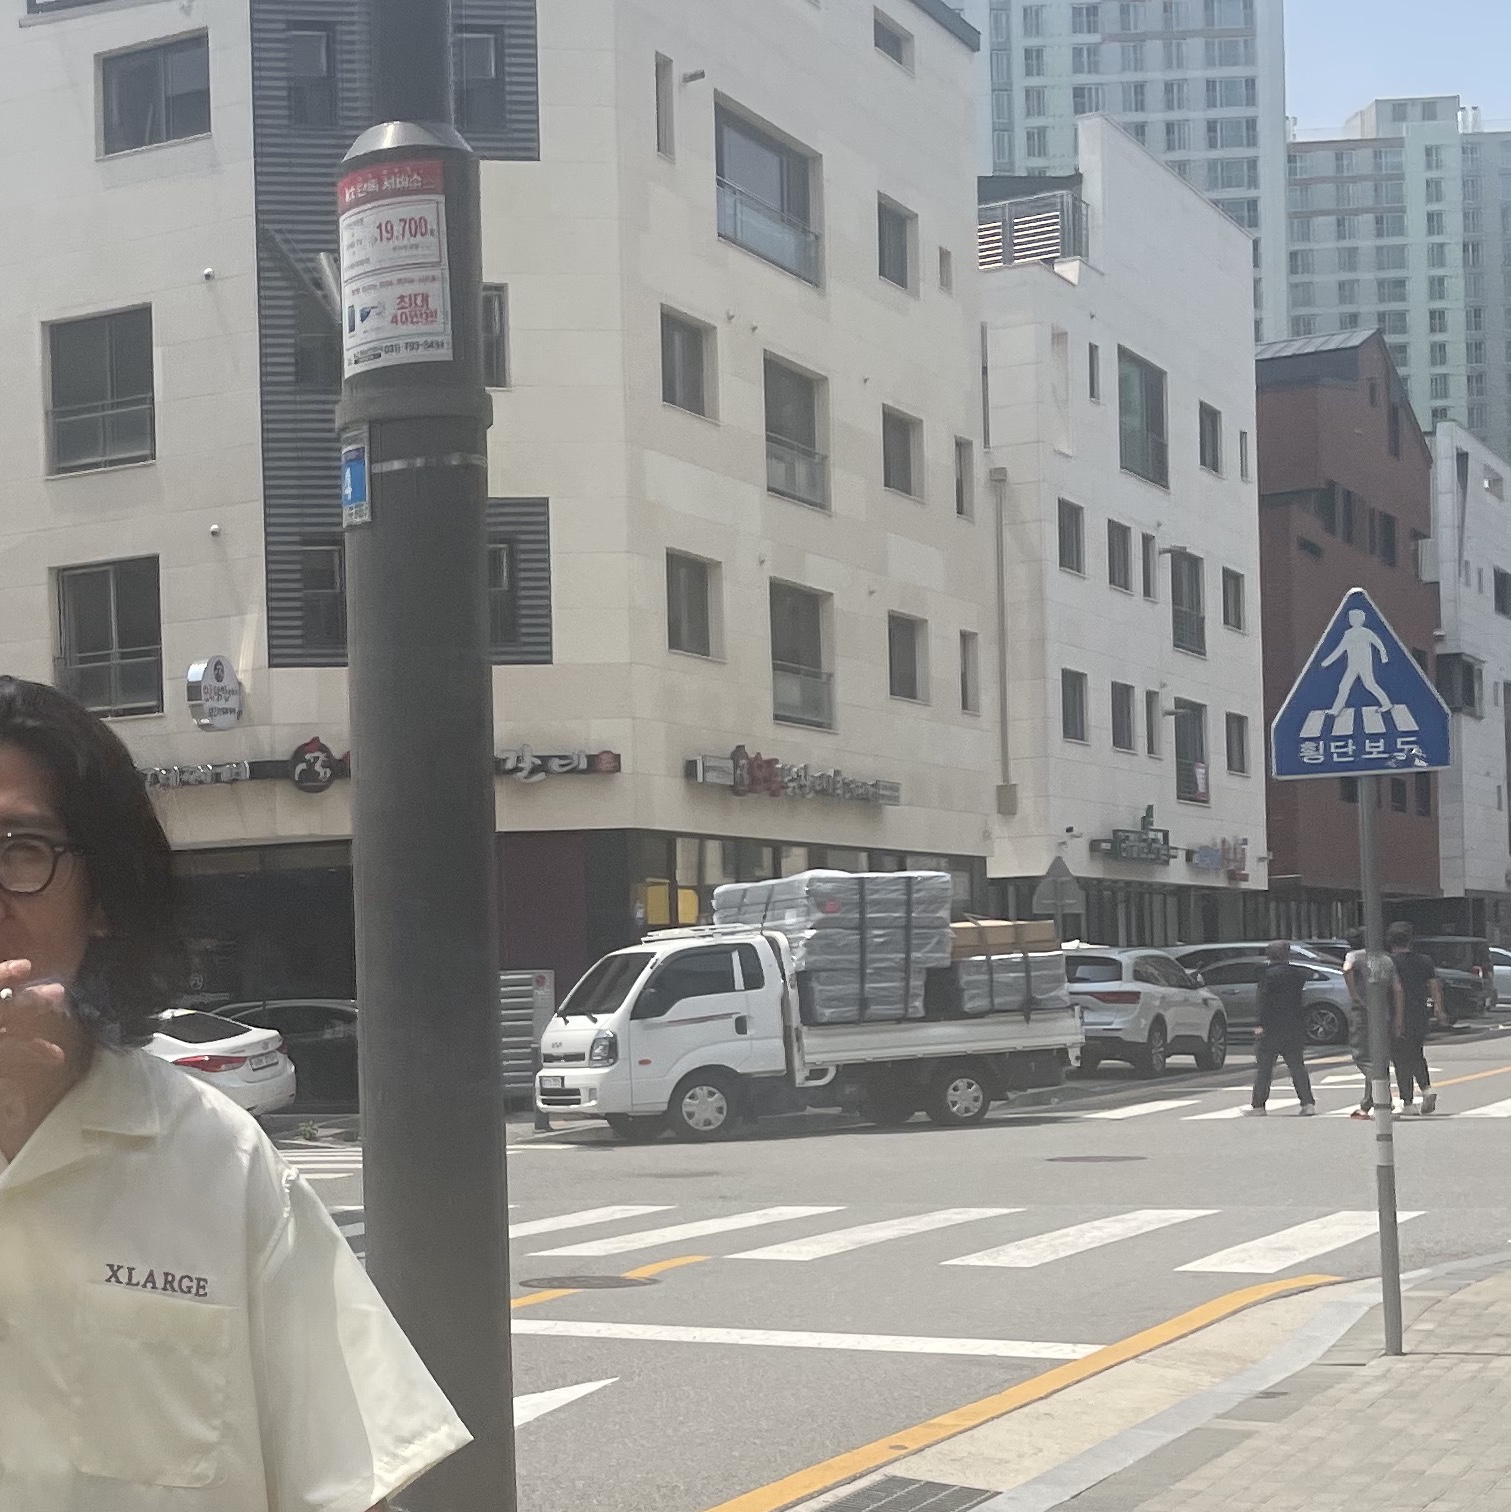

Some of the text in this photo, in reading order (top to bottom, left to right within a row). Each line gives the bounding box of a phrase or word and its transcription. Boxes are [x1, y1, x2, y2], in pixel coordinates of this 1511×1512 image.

[396, 292, 430, 310] 최대
[1299, 737, 1423, 764] 횡단보도
[104, 1263, 209, 1298] XLARGE
